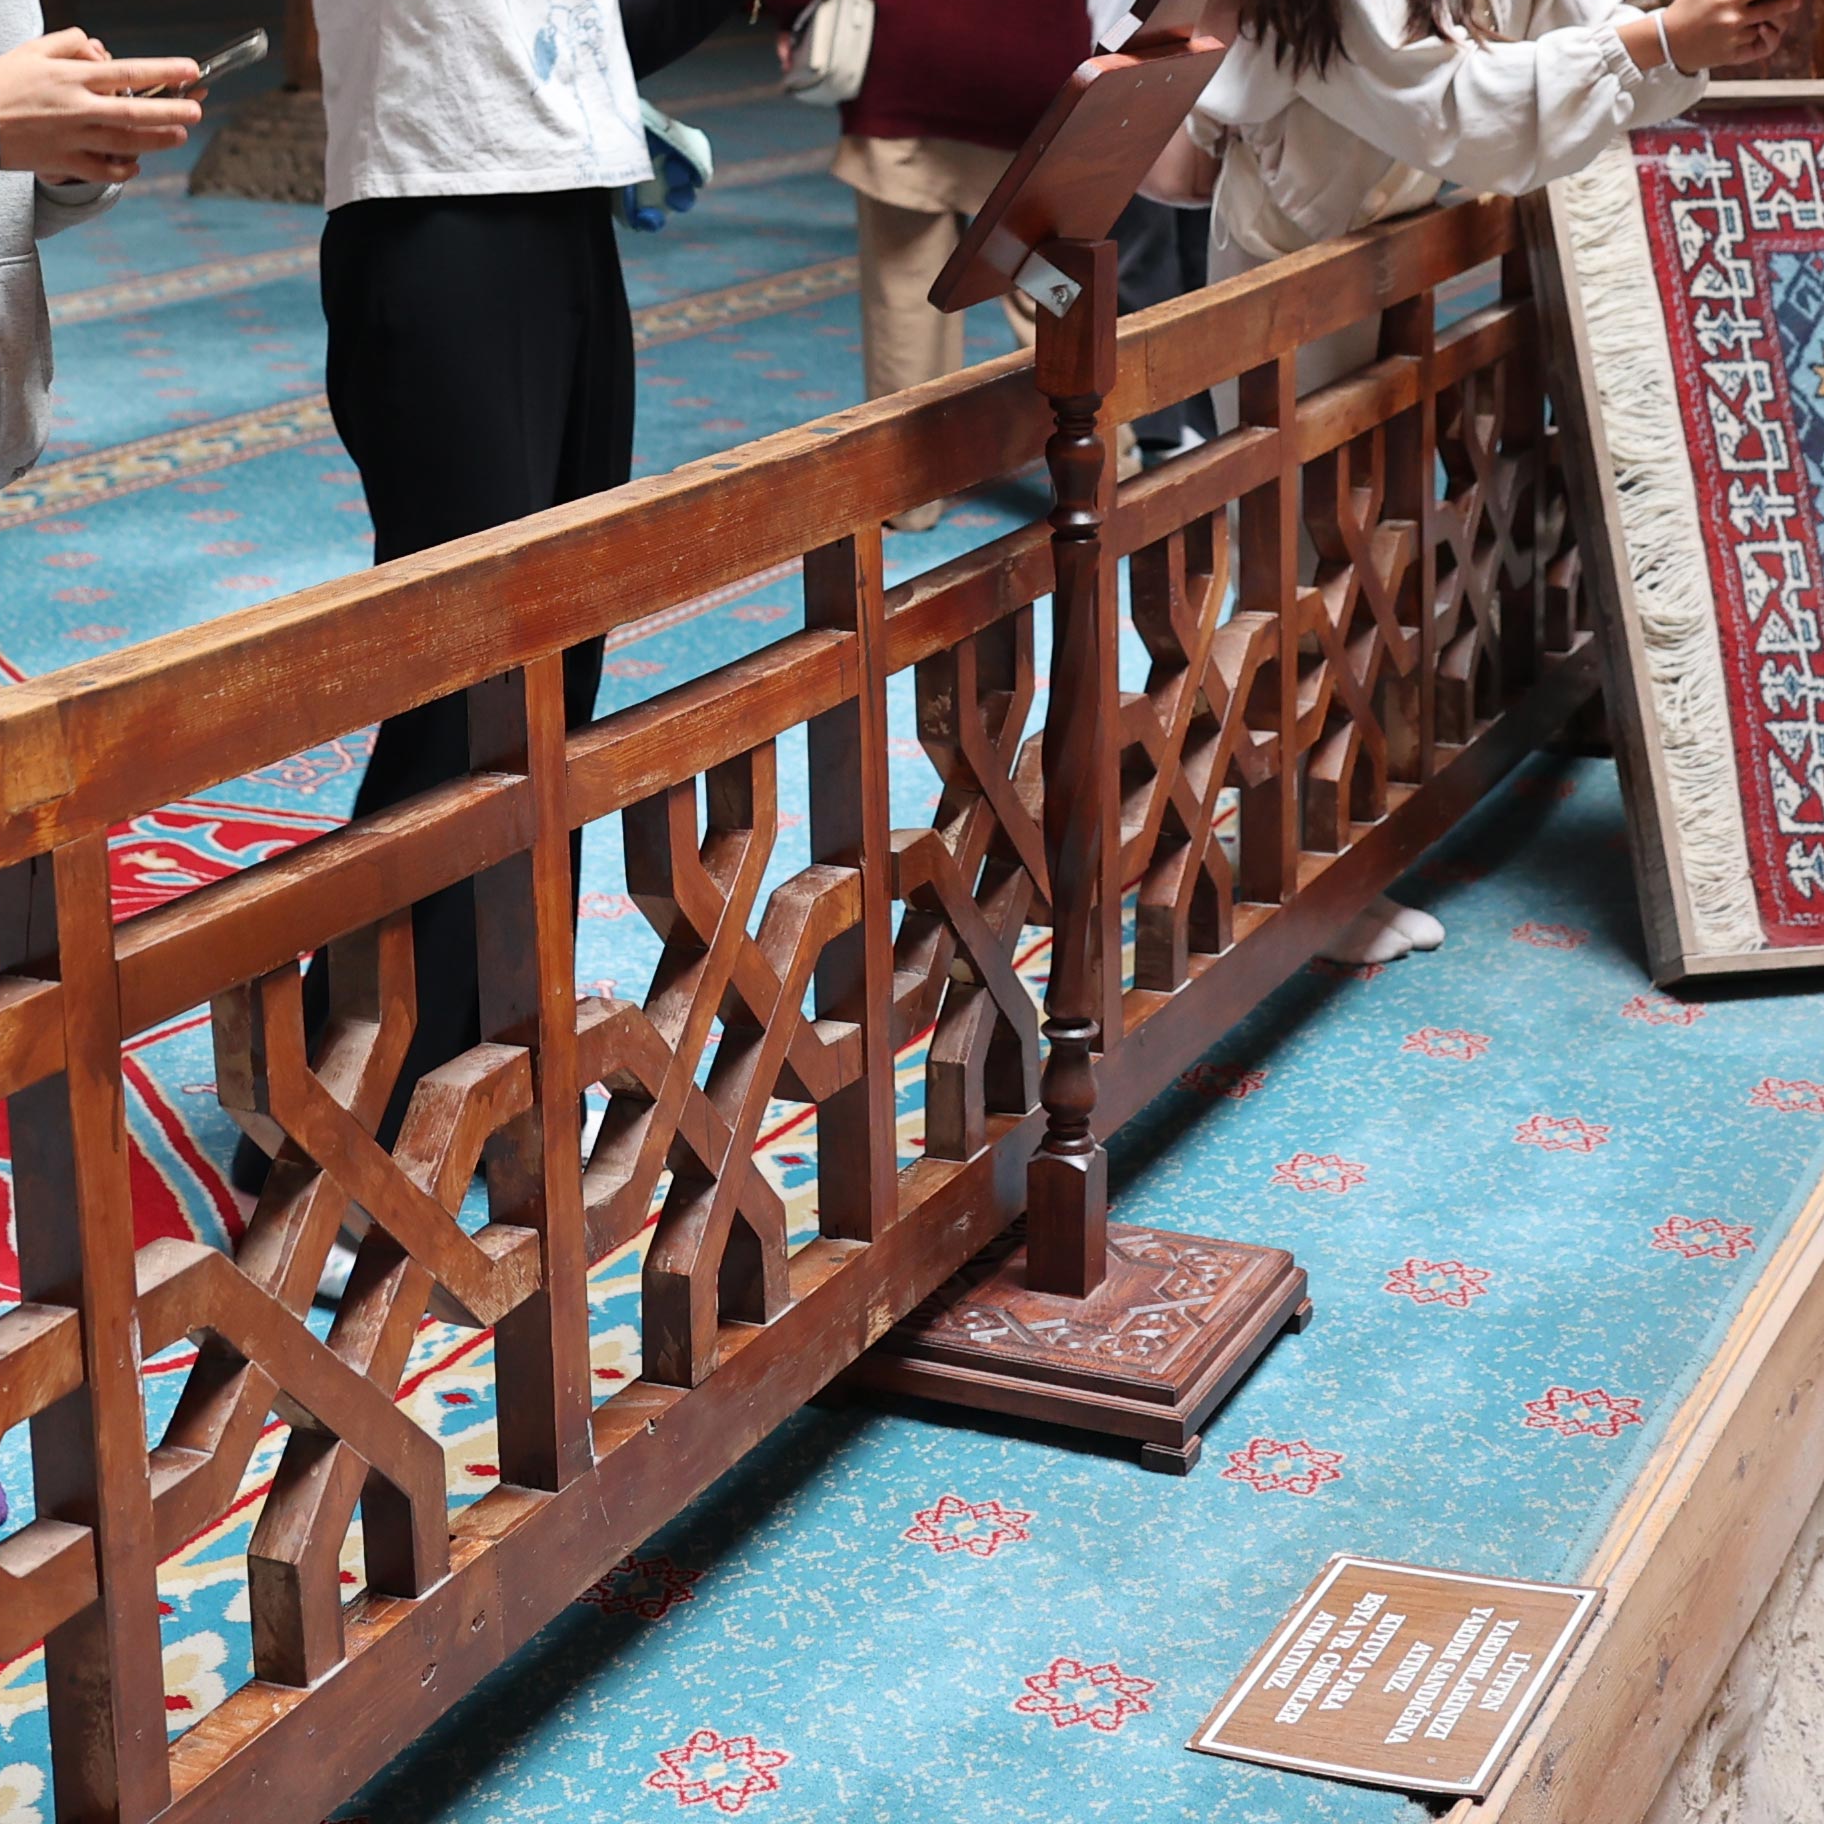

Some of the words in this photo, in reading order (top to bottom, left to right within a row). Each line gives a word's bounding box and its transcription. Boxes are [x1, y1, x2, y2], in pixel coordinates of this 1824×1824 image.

[1344, 1591, 1387, 1626] EŞYA
[1439, 1607, 1494, 1662] YARDIM
[1262, 1609, 1337, 1689] ATMAYINIZ.
[1326, 1629, 1361, 1650] VB.
[1347, 1612, 1406, 1668] KUYUYA
[1382, 1640, 1434, 1692] ATINIZ.
[1274, 1652, 1340, 1724] CİSİMLER
[1318, 1669, 1365, 1710] PARA
[1383, 1660, 1458, 1744] SANDIĞINA
[1423, 1619, 1519, 1740] YARDIMLARINIZI
[1477, 1651, 1531, 1713] LÜTFEN
